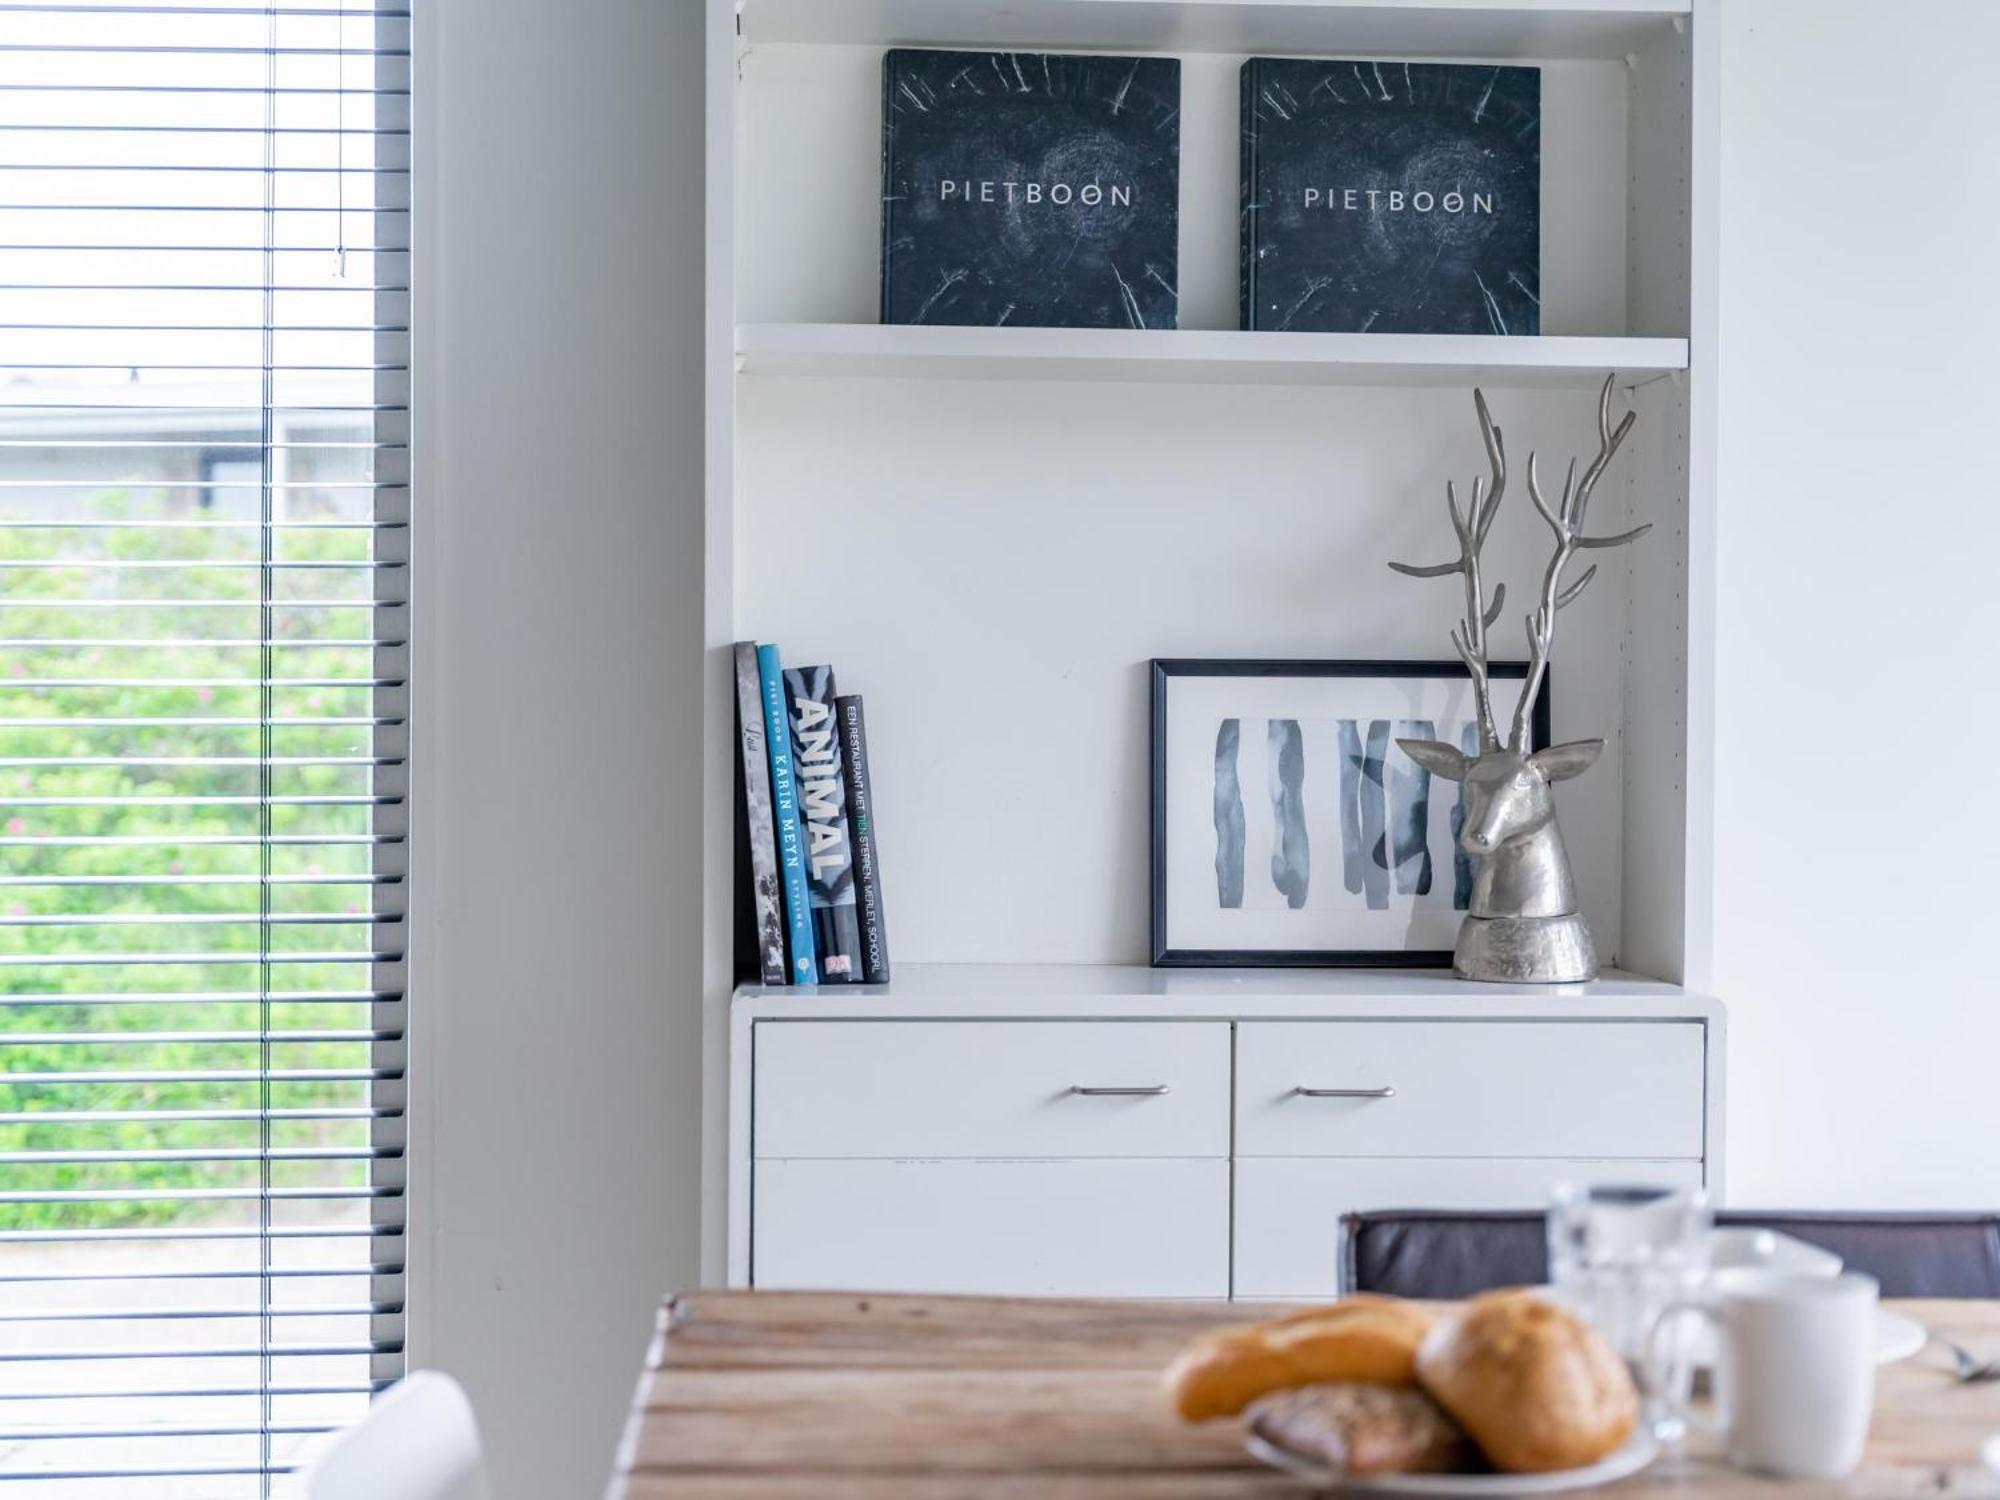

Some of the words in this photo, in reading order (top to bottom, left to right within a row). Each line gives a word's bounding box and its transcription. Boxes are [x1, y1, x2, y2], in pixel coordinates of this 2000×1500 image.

[940, 180, 1132, 208] PIETBOON
[1303, 186, 1494, 215] PIETBOON
[847, 706, 857, 725] EEN
[850, 727, 863, 788] RESTAURANT
[776, 754, 792, 810] KARIN
[795, 697, 845, 880] ANIMAL
[855, 790, 866, 811] MET
[857, 813, 867, 833] TIEN
[783, 819, 798, 867] MEYN
[868, 927, 880, 973] SCHOORL
